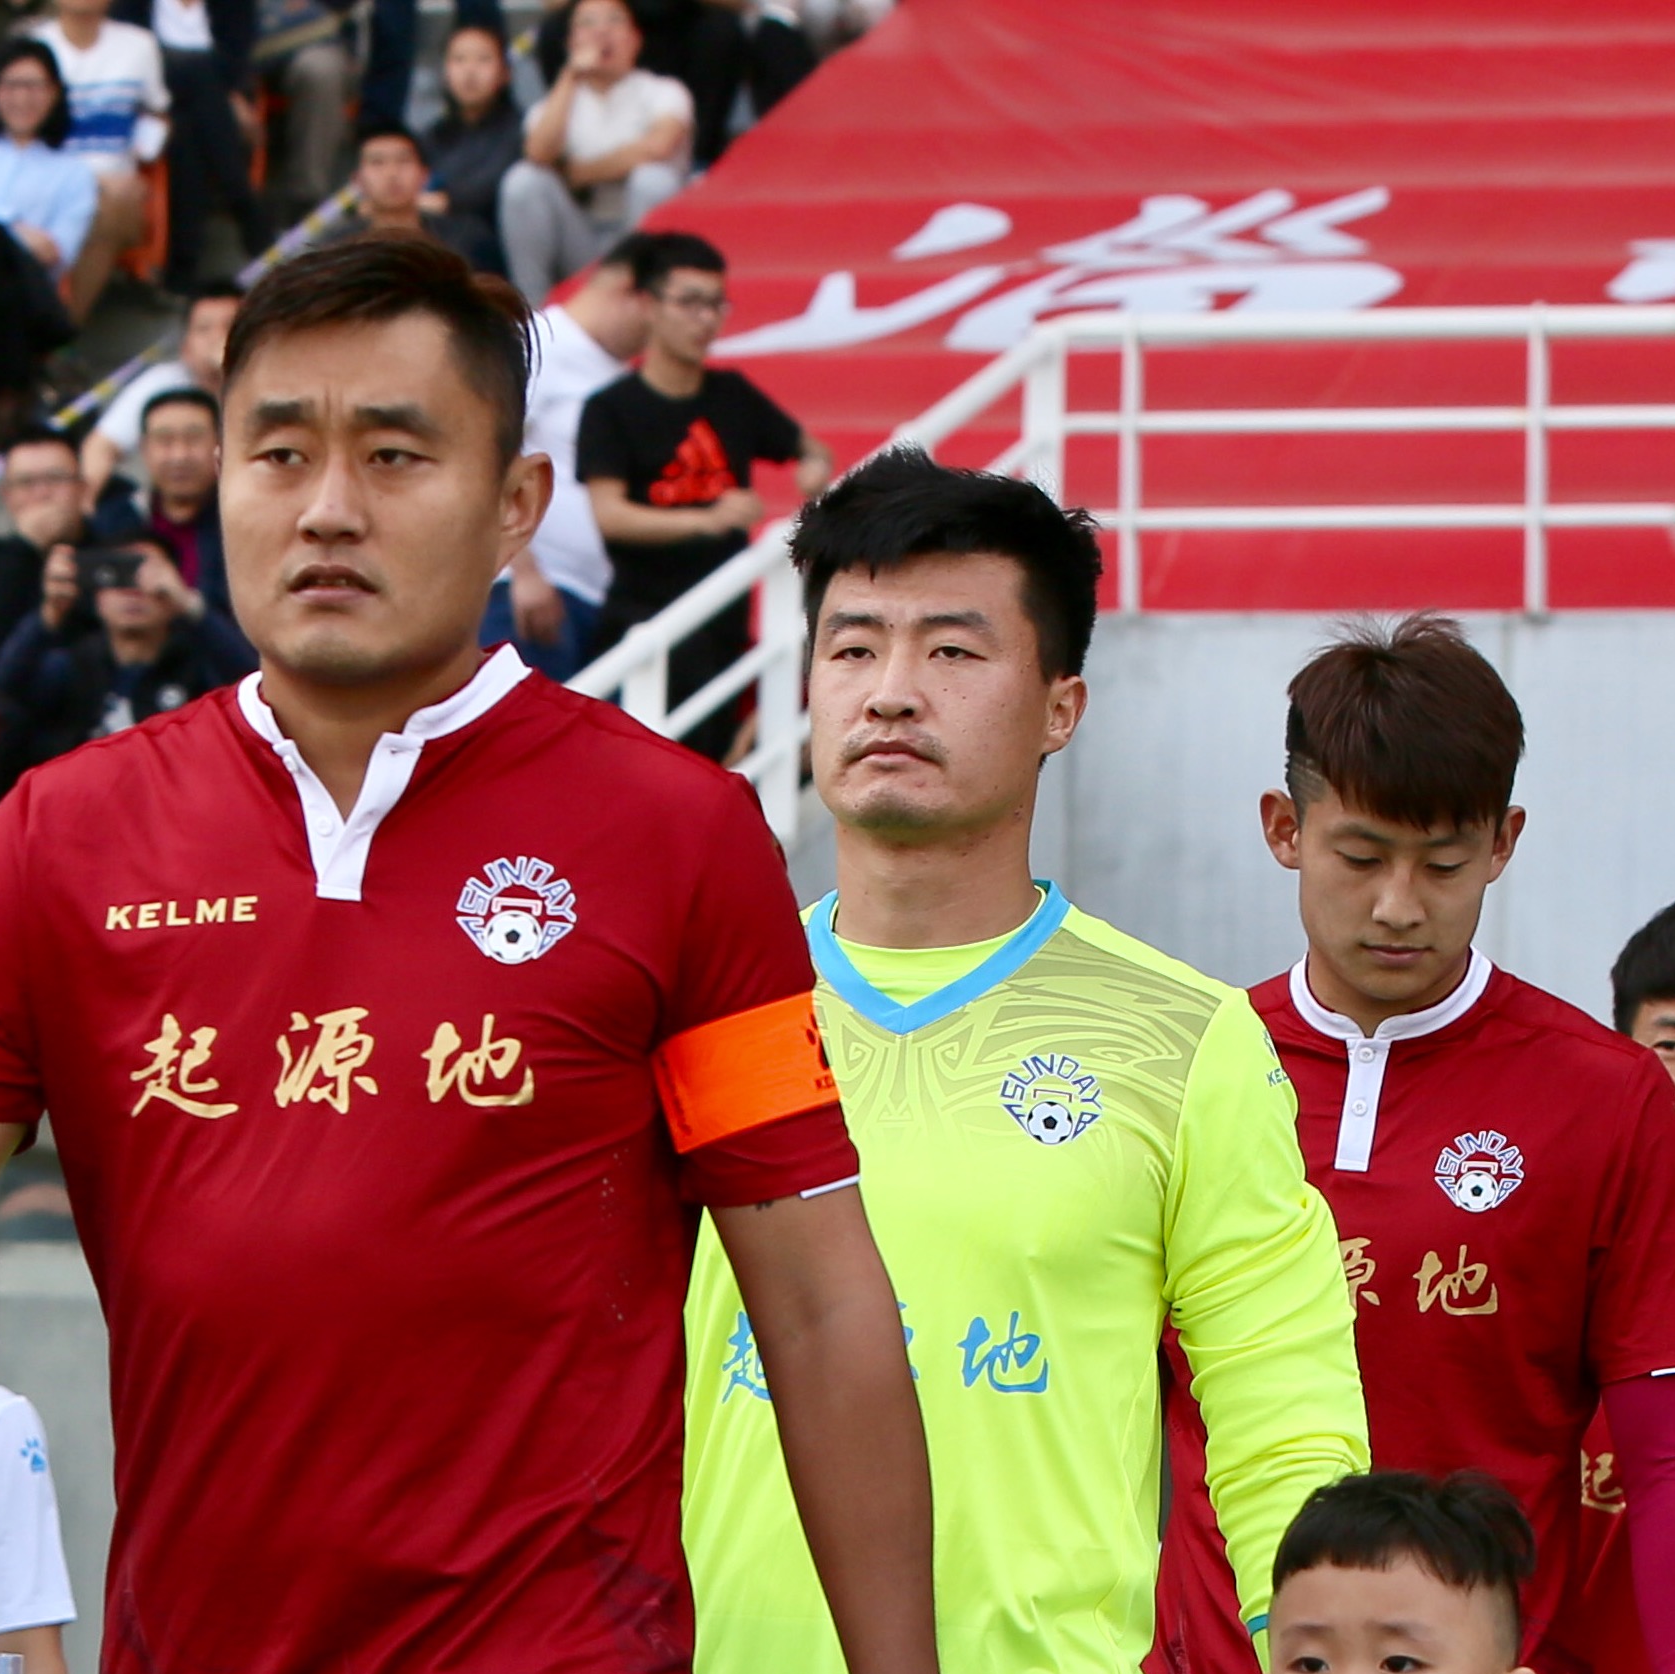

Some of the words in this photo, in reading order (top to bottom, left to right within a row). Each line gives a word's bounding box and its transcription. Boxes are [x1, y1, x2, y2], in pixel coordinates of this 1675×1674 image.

[106, 896, 258, 930] KELME
[456, 856, 577, 923] SUNDAY
[130, 1006, 534, 1119] 起源地
[1000, 1053, 1102, 1110] SUNDAY
[1435, 1130, 1524, 1178] SUNDAY
[722, 1302, 1048, 1404] 起地
